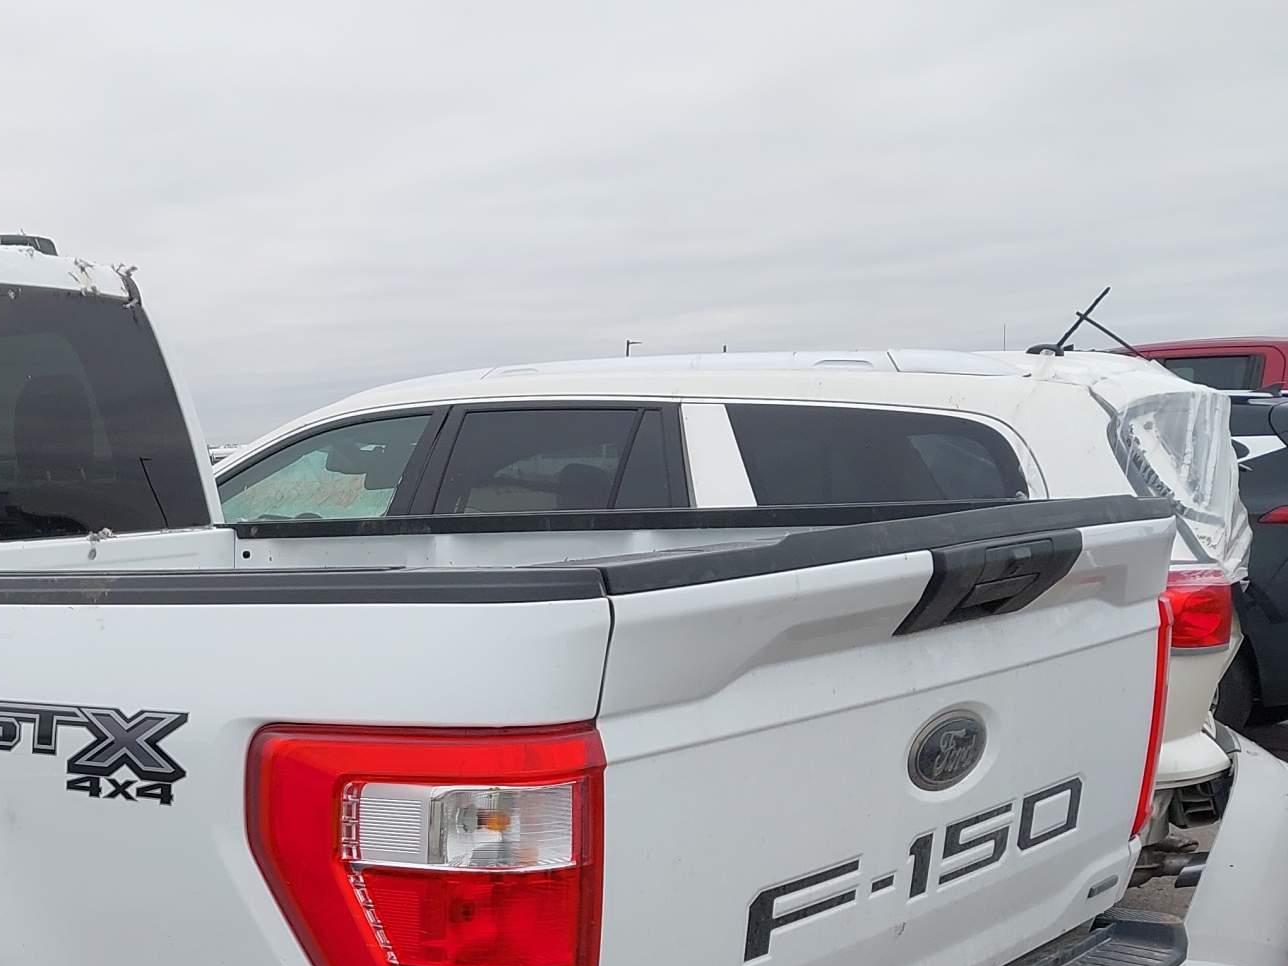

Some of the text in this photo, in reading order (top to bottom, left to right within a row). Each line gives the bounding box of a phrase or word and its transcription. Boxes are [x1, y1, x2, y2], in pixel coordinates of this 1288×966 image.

[933, 728, 977, 777] Ford
[66, 775, 173, 806] 4x4
[742, 776, 1083, 963] F-150
